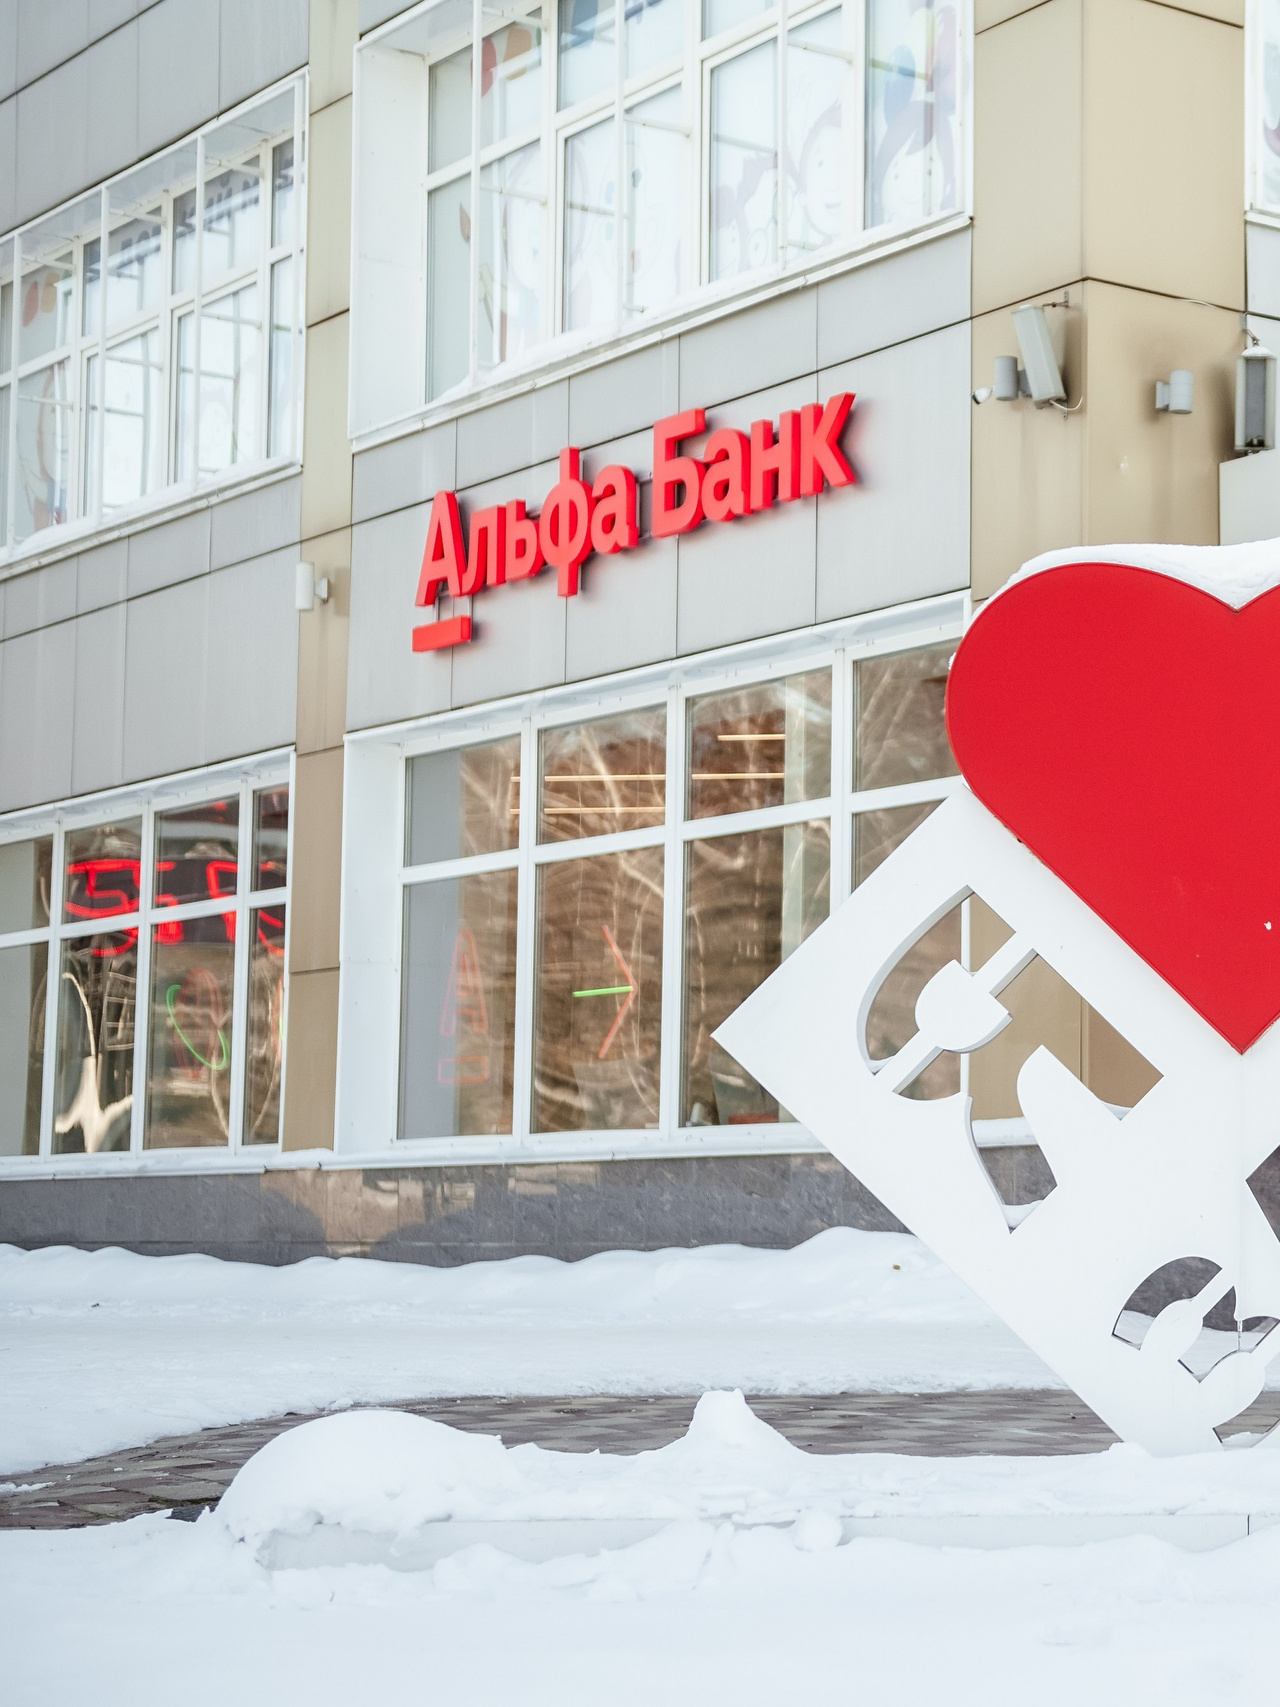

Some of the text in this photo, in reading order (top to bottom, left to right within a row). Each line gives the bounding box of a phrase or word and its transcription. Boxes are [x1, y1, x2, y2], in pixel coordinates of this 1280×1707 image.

[415, 392, 856, 607] Альфа Банк
[857, 884, 1164, 1234] Я
